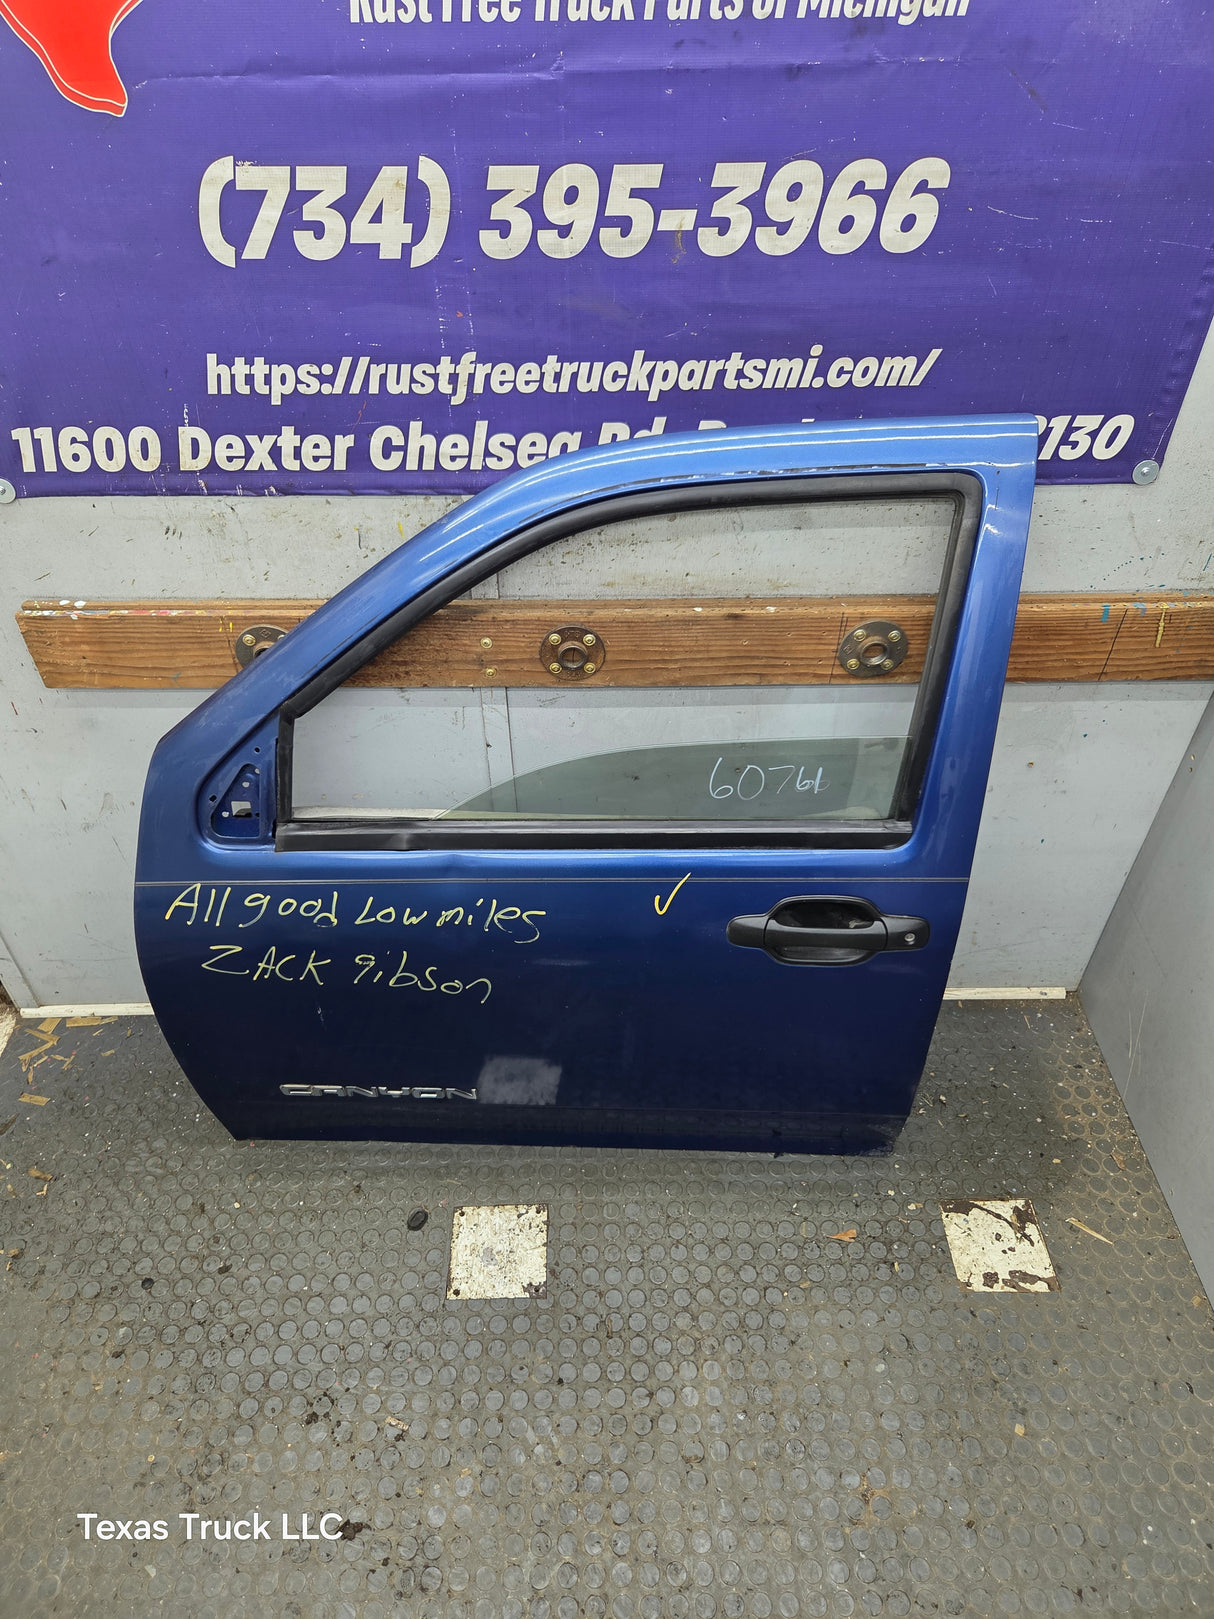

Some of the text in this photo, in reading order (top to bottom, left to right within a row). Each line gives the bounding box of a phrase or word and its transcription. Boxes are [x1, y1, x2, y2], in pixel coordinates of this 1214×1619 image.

[198, 155, 951, 269] (734) 395-3966
[206, 348, 943, 405] https://rustfreetruckpartsmi.com/
[11, 426, 161, 473] 11600
[177, 426, 355, 472] Dexter
[165, 883, 232, 928] All
[238, 892, 339, 929] good
[200, 945, 333, 986] ZACK
[279, 1083, 478, 1101] CANYON
